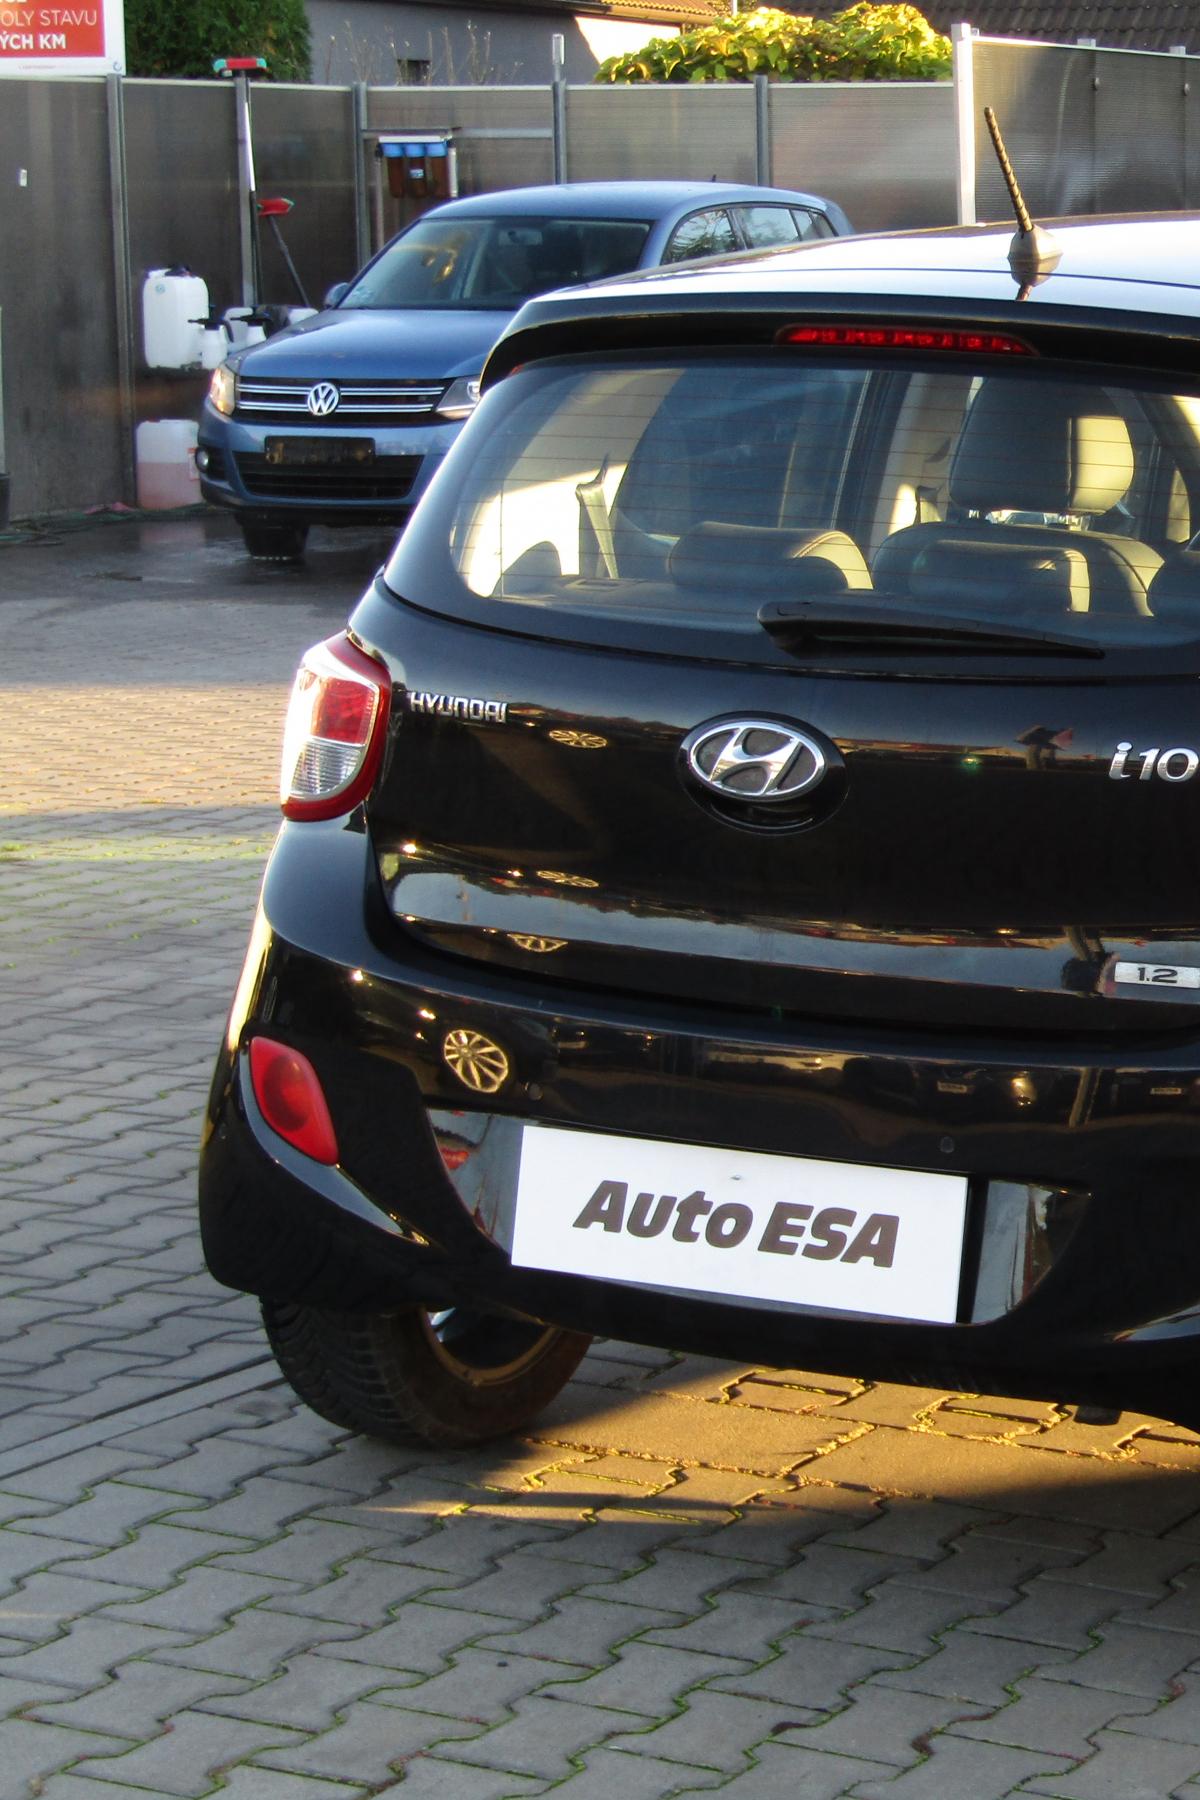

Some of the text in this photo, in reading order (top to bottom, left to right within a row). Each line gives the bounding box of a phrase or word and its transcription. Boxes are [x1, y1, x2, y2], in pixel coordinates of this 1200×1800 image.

[1, 9, 97, 27] OLY STAVU
[39, 33, 67, 50] KM
[409, 691, 509, 723] HYUNDAI
[1108, 742, 1200, 782] i10
[1137, 966, 1178, 984] 1.2
[572, 1179, 900, 1268] Auto ESA
